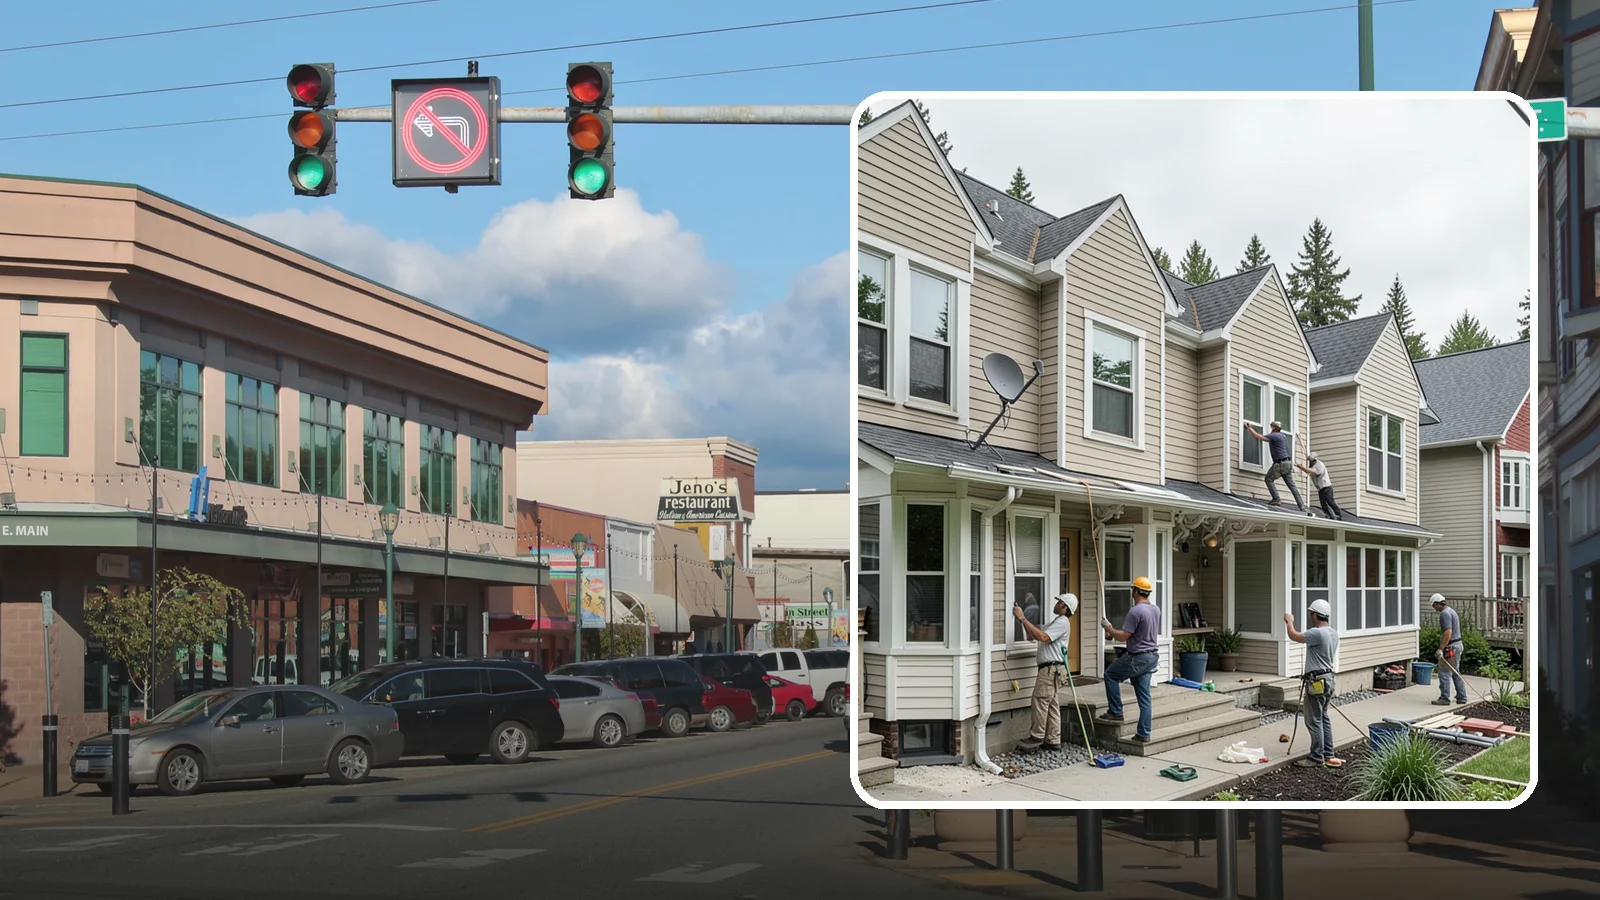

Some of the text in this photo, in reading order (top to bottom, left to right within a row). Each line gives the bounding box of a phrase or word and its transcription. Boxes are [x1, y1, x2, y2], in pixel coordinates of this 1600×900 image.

[669, 480, 728, 495] Jeno's
[665, 496, 731, 509] restaurant
[686, 510, 714, 519] American
[715, 510, 737, 519] Cuisine
[2, 525, 49, 537] E. MAIN
[797, 607, 828, 617] Street
[790, 619, 824, 627] lass
